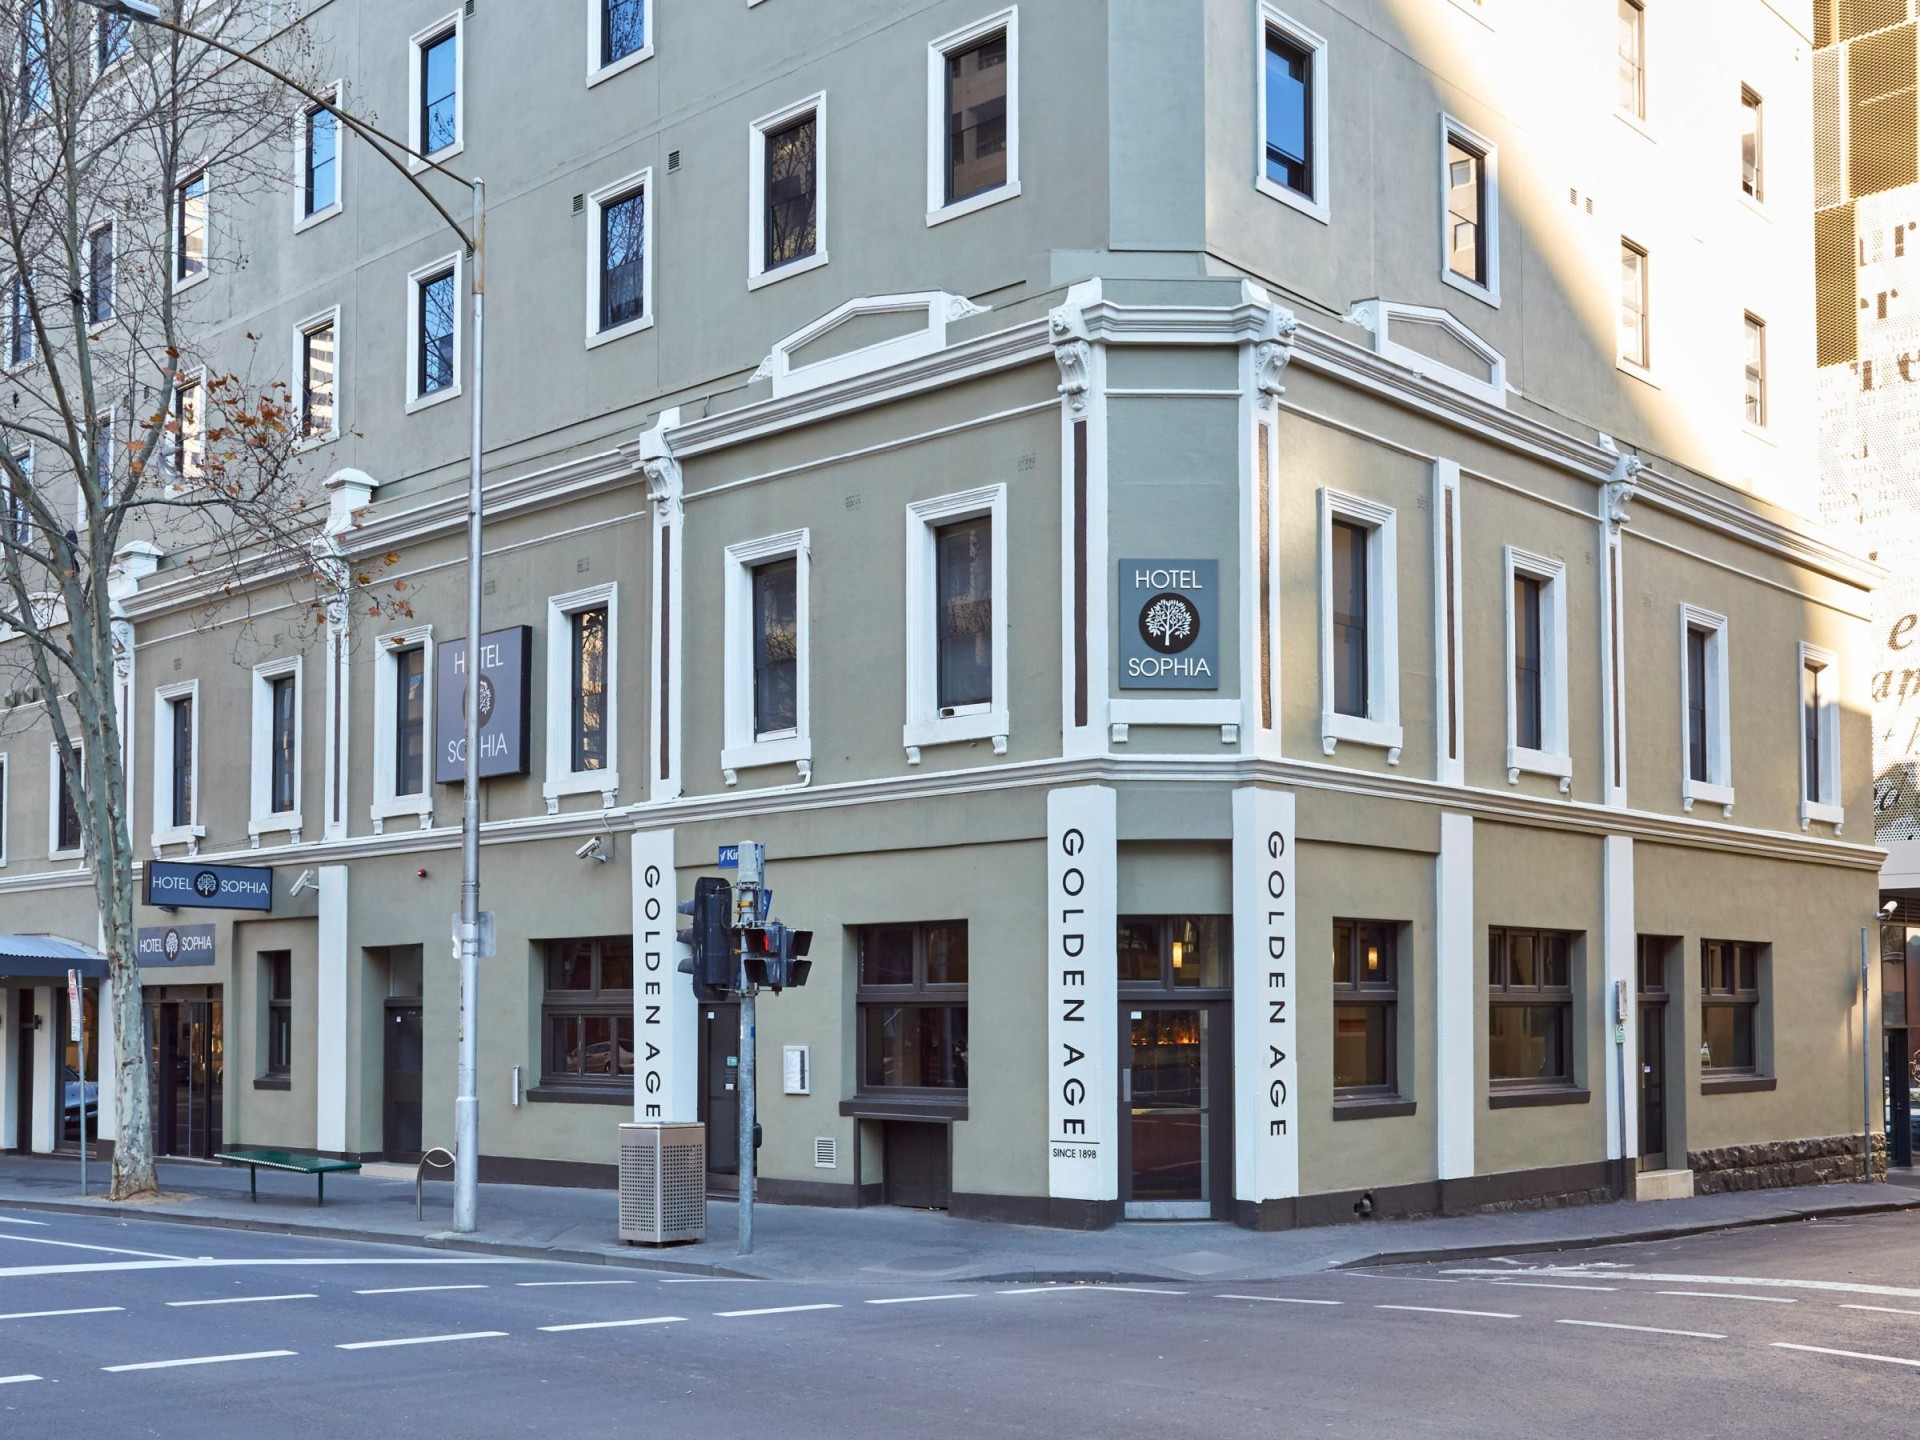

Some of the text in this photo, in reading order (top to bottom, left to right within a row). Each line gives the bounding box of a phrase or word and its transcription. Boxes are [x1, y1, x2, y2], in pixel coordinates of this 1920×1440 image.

[1135, 569, 1203, 589] HOTEL
[454, 643, 504, 675] HTEL
[1128, 657, 1211, 677] SOPHIA
[447, 732, 508, 763] SOHIA
[152, 876, 269, 894] HOTEL SOPHIA
[139, 935, 212, 953] HOTEL SOPHIA
[644, 864, 661, 1118] GOLDEN AGE
[1062, 828, 1086, 1135] GOLDEN AGE
[1268, 830, 1287, 1136] GOLDEN AGE
[1052, 1148, 1097, 1159] SINCE 1898
